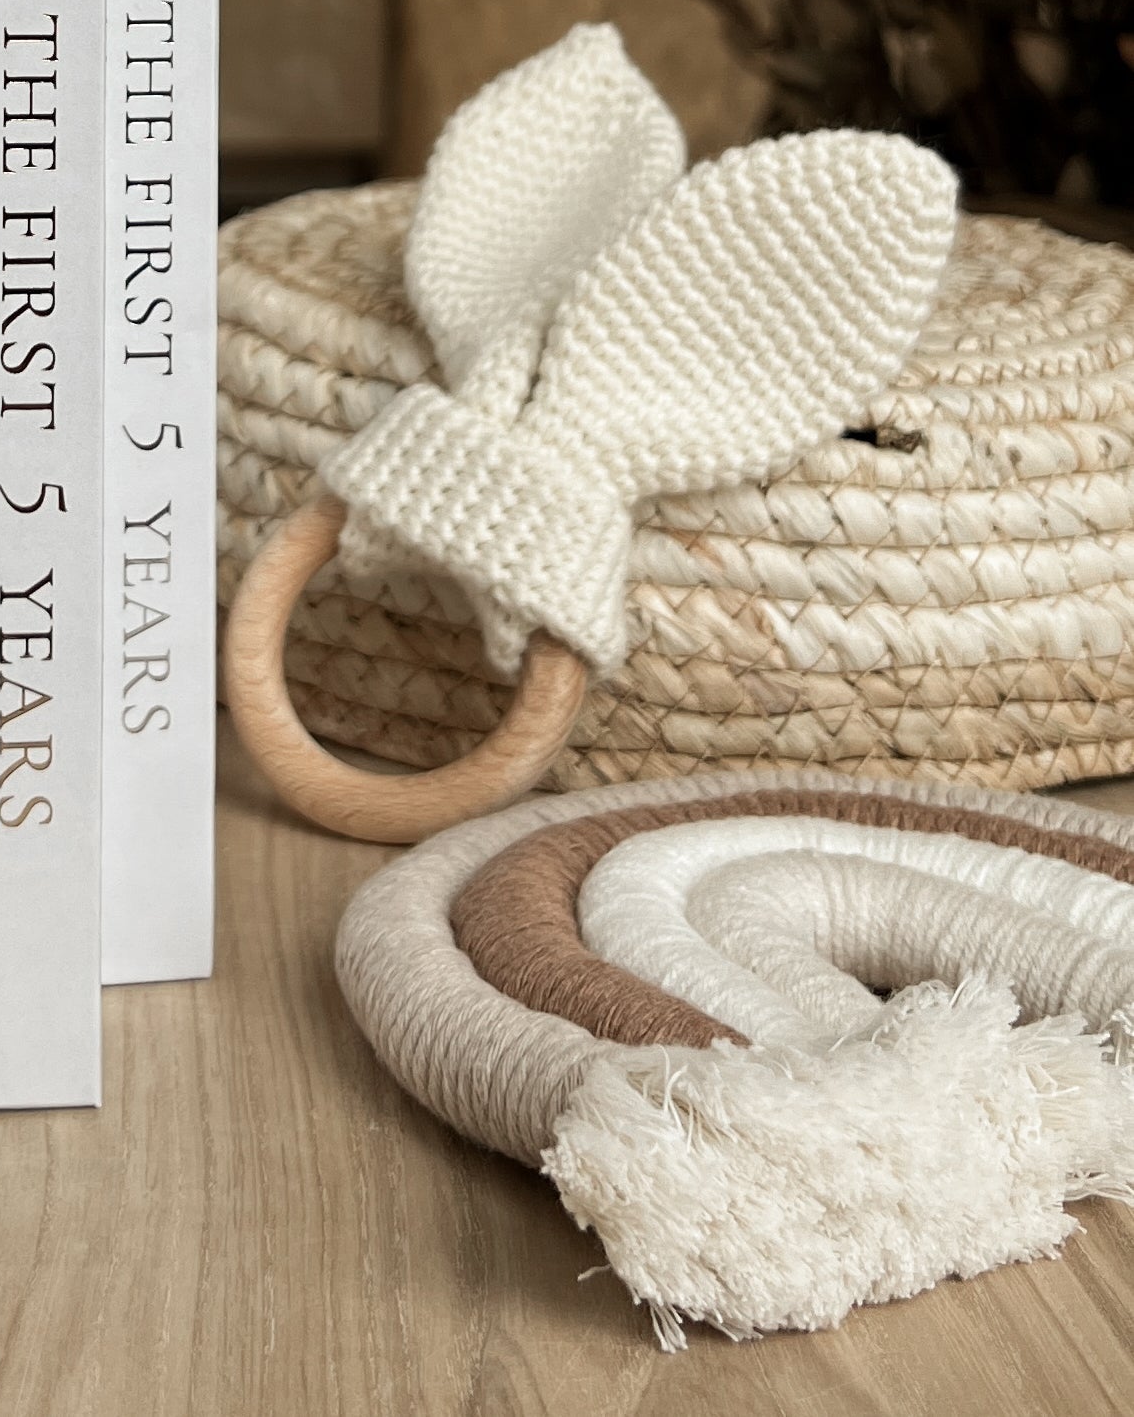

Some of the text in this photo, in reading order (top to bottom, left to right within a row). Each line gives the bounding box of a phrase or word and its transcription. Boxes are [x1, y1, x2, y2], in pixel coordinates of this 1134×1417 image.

[2, 13, 59, 174] THE
[125, 0, 175, 144] THE
[0, 205, 57, 430] FIRST
[123, 174, 174, 375] FIRST
[122, 423, 184, 451] 5
[121, 499, 172, 734] YEARS
